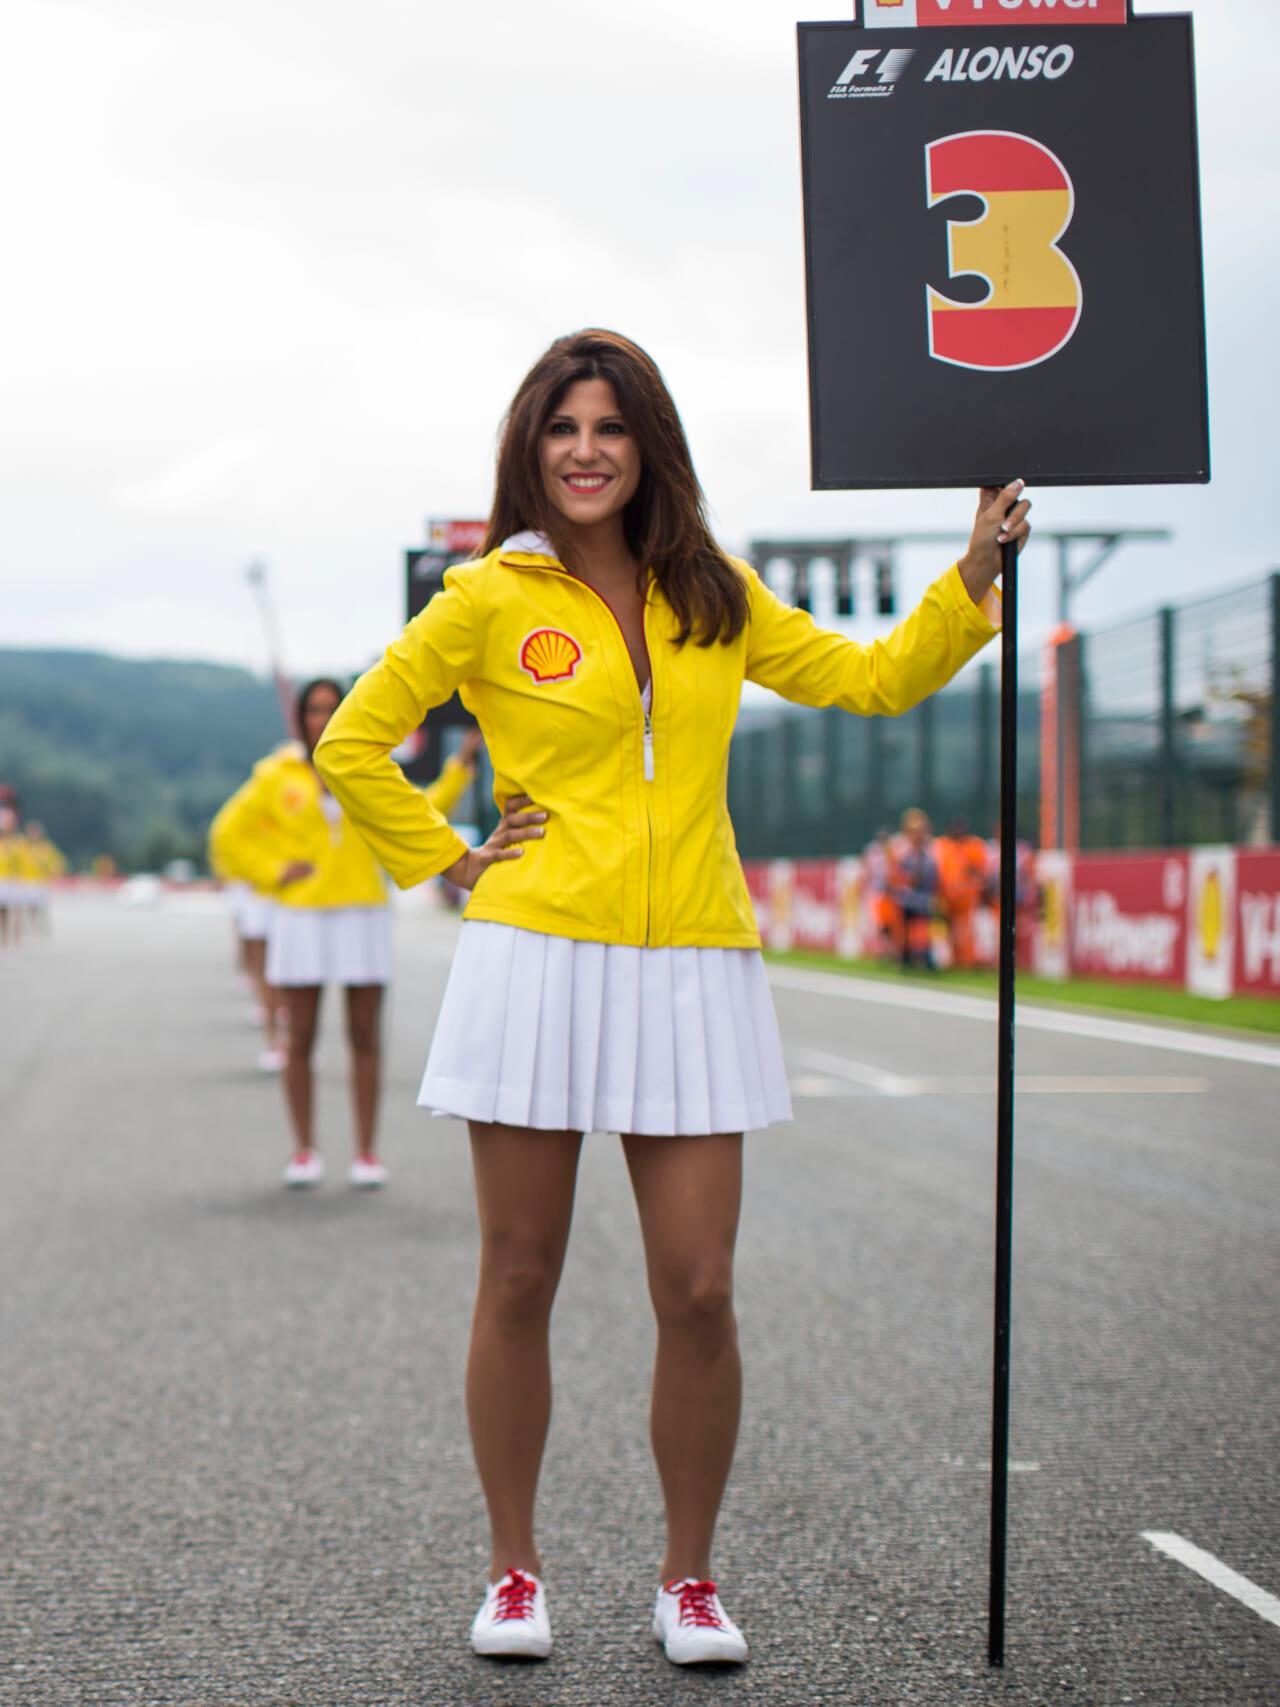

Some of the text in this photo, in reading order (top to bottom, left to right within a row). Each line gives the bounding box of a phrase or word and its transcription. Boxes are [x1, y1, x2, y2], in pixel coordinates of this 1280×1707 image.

[835, 44, 1074, 85] F1 ALONSO
[925, 129, 1083, 371] 3
